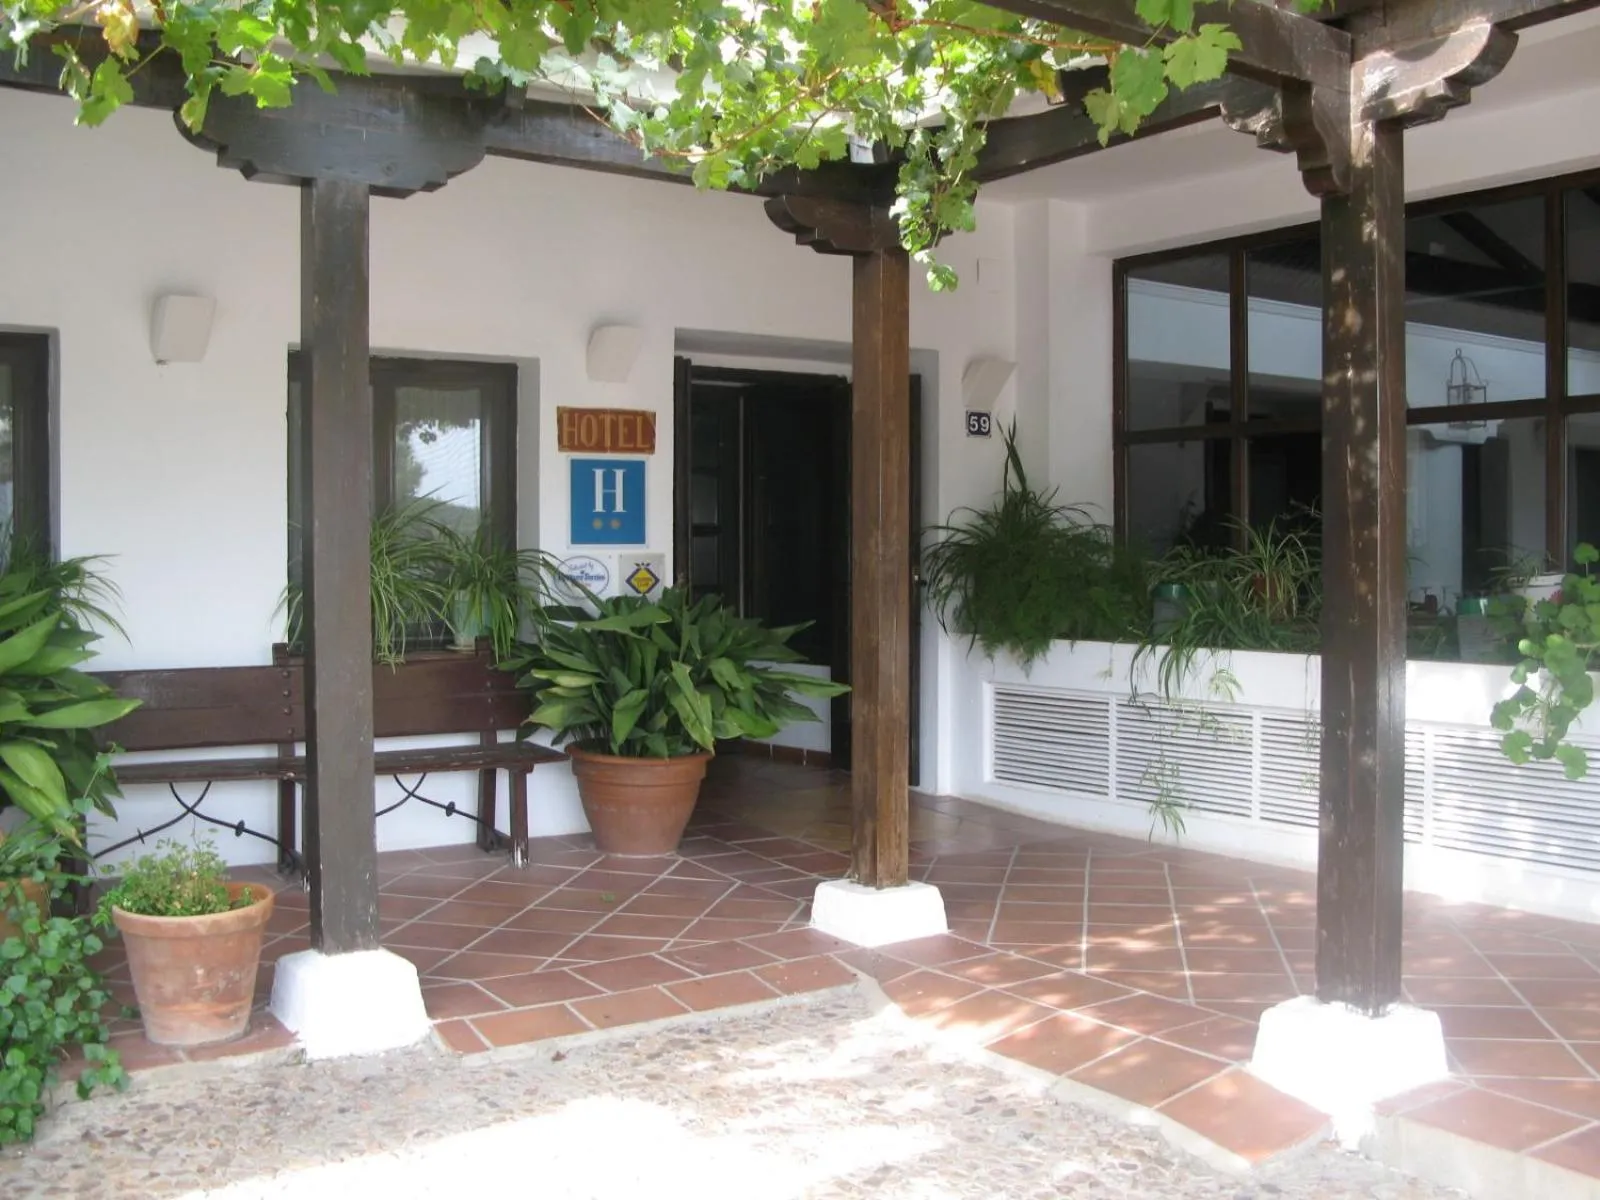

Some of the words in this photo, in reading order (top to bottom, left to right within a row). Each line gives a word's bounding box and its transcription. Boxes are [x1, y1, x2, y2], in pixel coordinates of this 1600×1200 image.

[562, 413, 651, 448] HOTEL
[969, 416, 989, 433] 59
[592, 469, 627, 512] H
